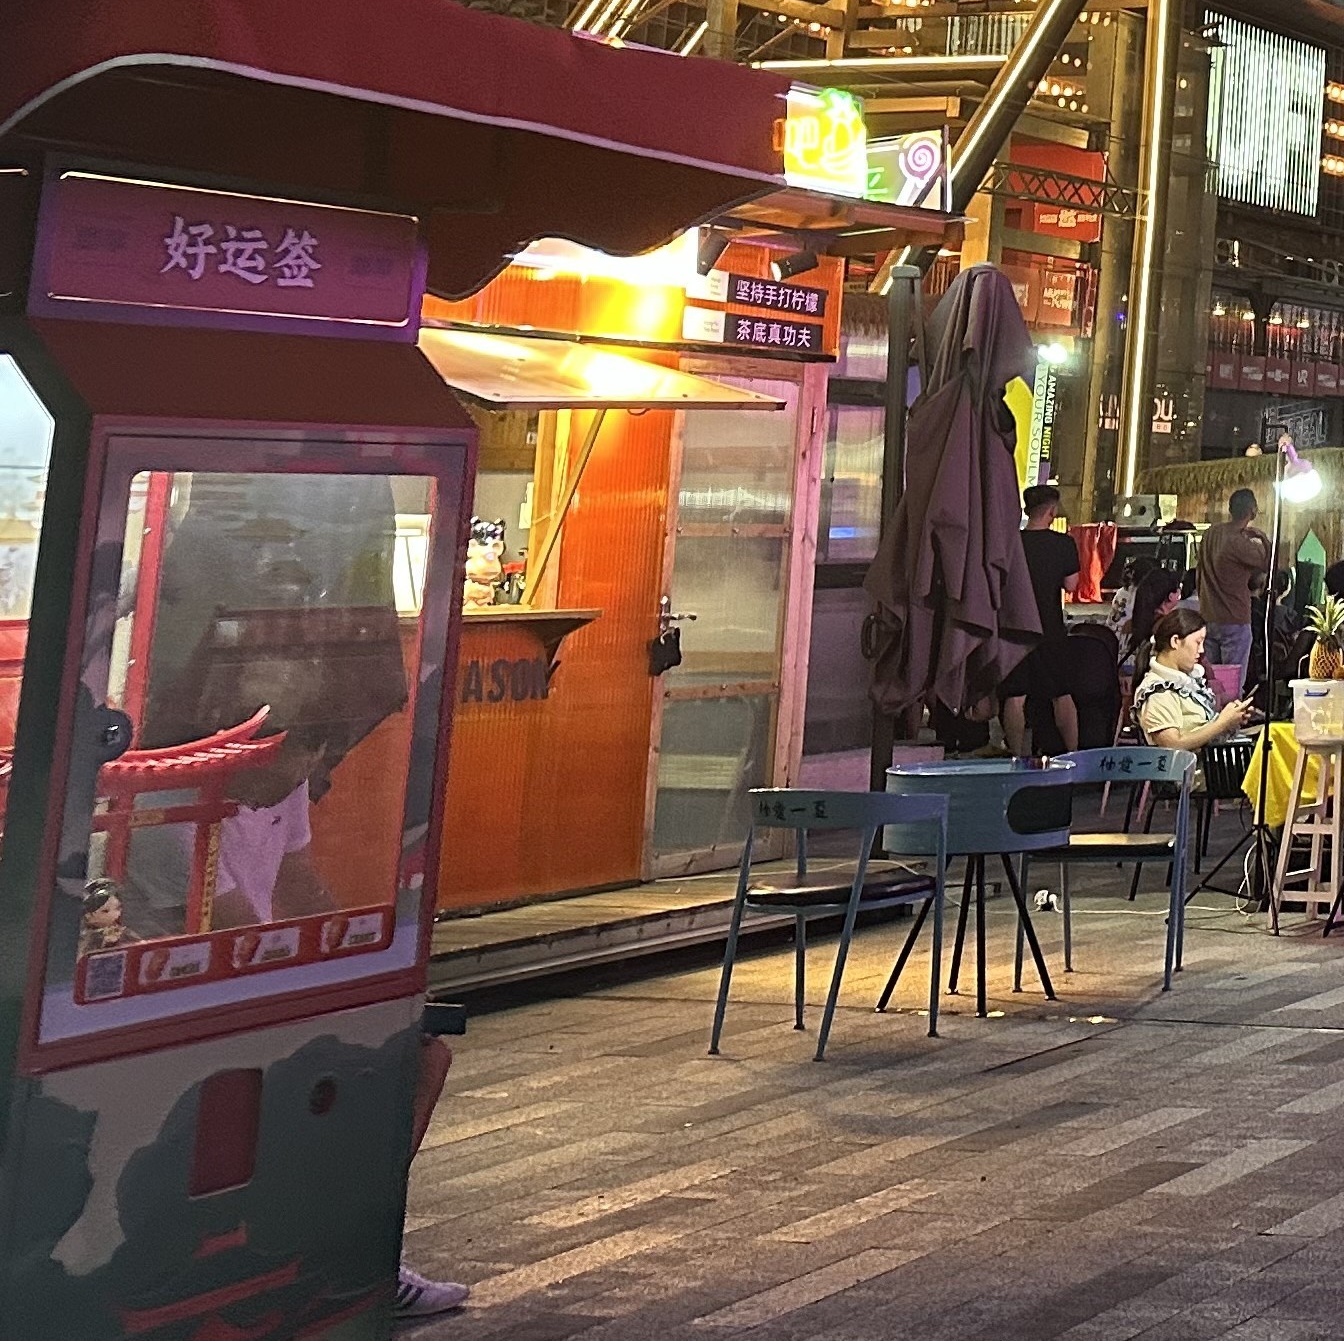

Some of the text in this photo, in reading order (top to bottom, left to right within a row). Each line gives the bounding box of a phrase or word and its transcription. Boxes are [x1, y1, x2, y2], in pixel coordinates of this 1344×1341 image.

[159, 216, 322, 288] 好运签
[735, 278, 819, 313] 坚持手打柠檬
[736, 318, 812, 348] 茶底真功夫
[1034, 374, 1046, 424] YOUR
[1044, 375, 1057, 424] AMAZING
[1040, 427, 1053, 460] NIGHT
